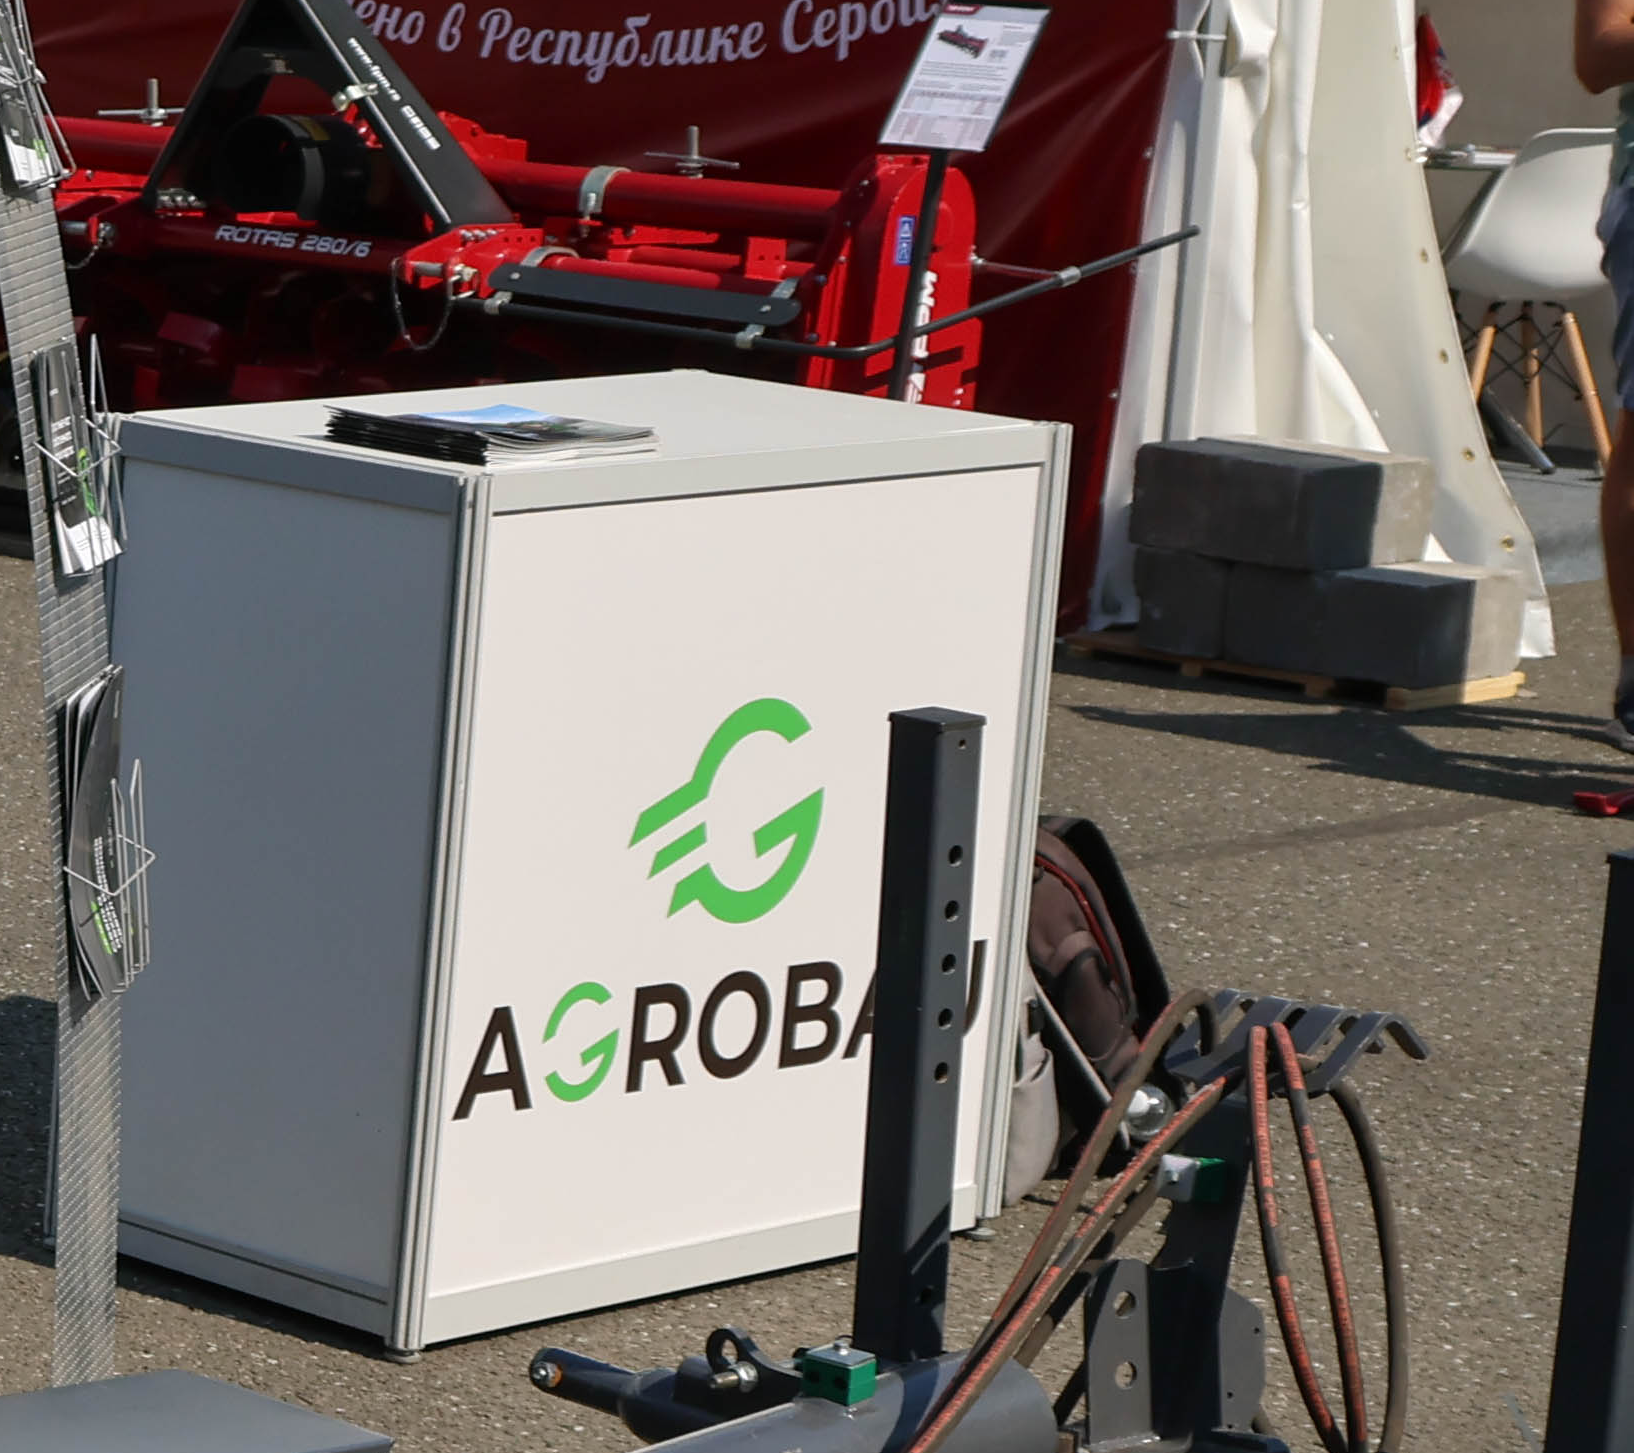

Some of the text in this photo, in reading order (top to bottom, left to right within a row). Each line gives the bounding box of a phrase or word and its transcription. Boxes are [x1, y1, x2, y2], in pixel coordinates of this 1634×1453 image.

[479, 7, 768, 83] Республике
[215, 224, 372, 258] ROTAS 280/6
[451, 938, 990, 1122] AGROB
